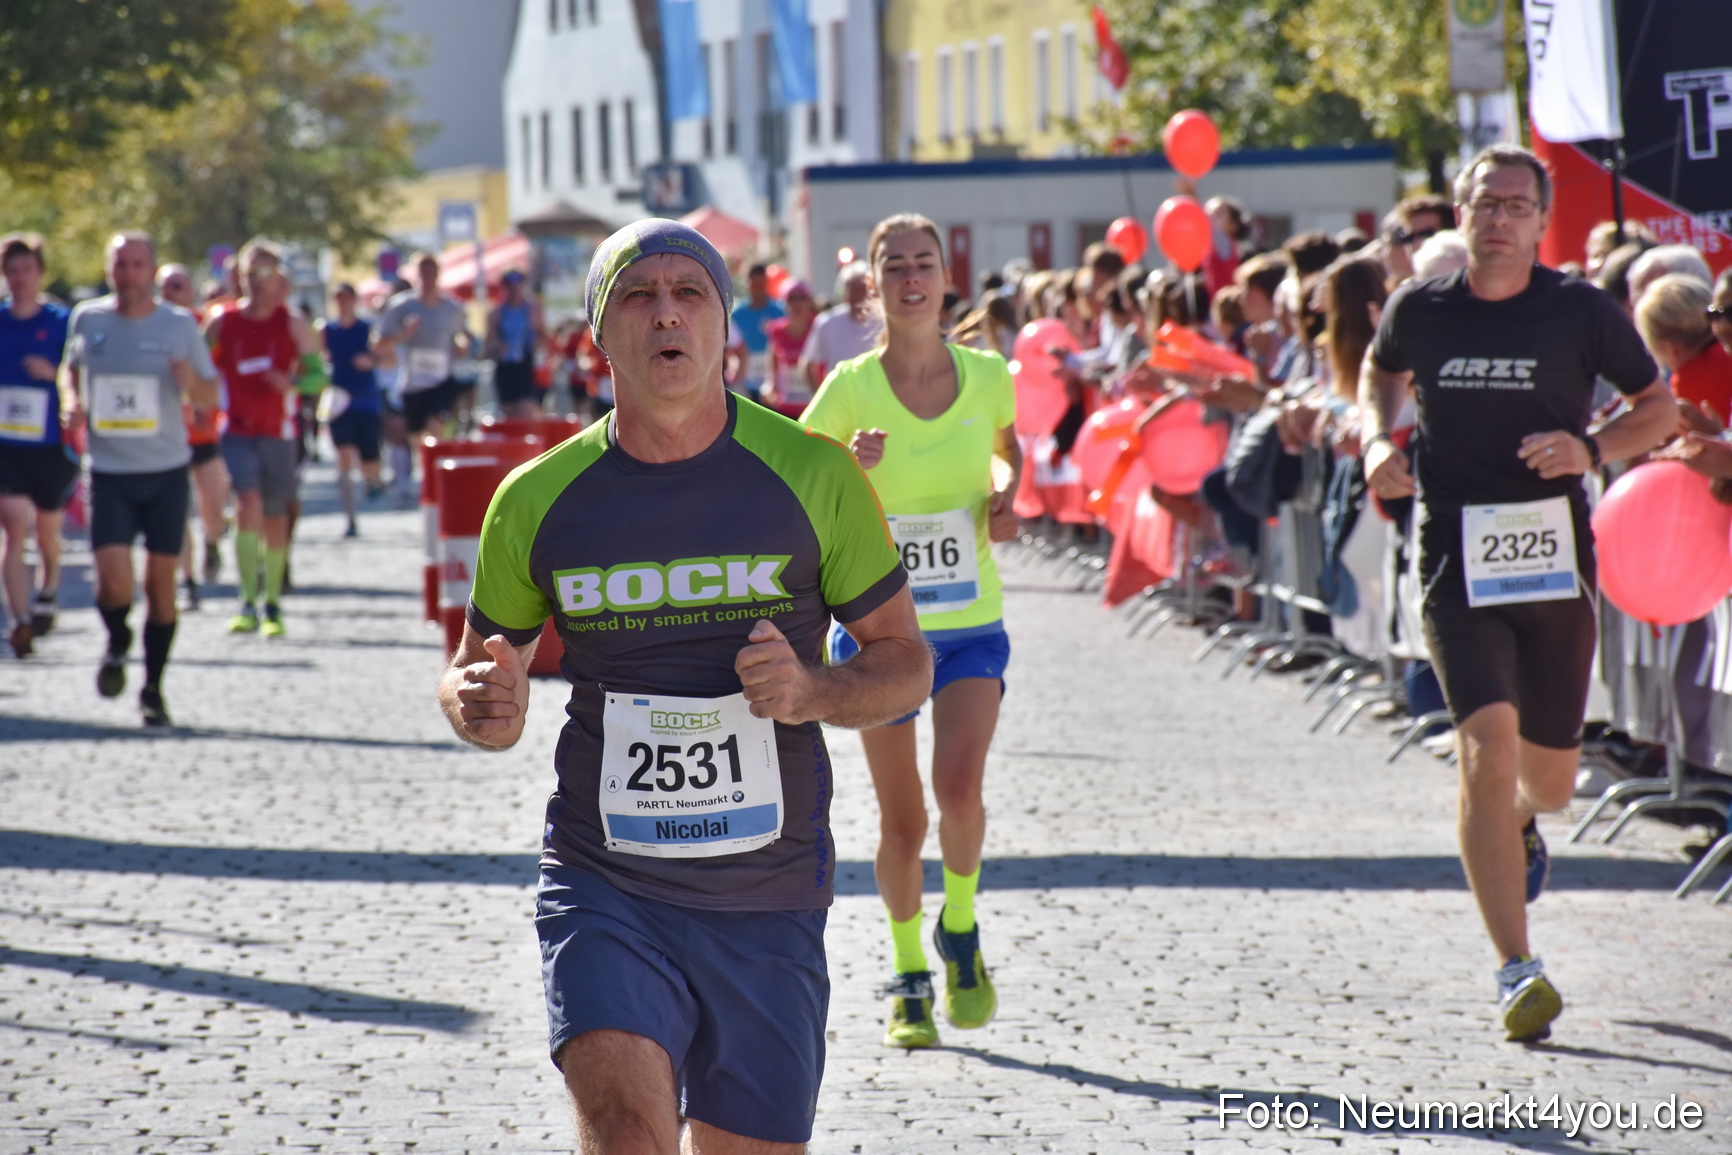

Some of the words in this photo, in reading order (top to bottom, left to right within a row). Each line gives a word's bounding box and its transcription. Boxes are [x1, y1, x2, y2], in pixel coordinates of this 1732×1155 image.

[895, 537, 960, 571] 616
[1481, 530, 1557, 562] 2325
[553, 556, 792, 616] BOCK
[911, 591, 938, 602] nes
[566, 616, 619, 633] inspired
[625, 615, 647, 631] by
[654, 610, 709, 627] smart
[715, 602, 794, 622] concepts
[651, 710, 721, 729] BOCK
[626, 734, 742, 792] 2531
[637, 800, 674, 809] PARTL
[677, 795, 728, 808] Neumarkt
[655, 816, 728, 839] Nicolai
